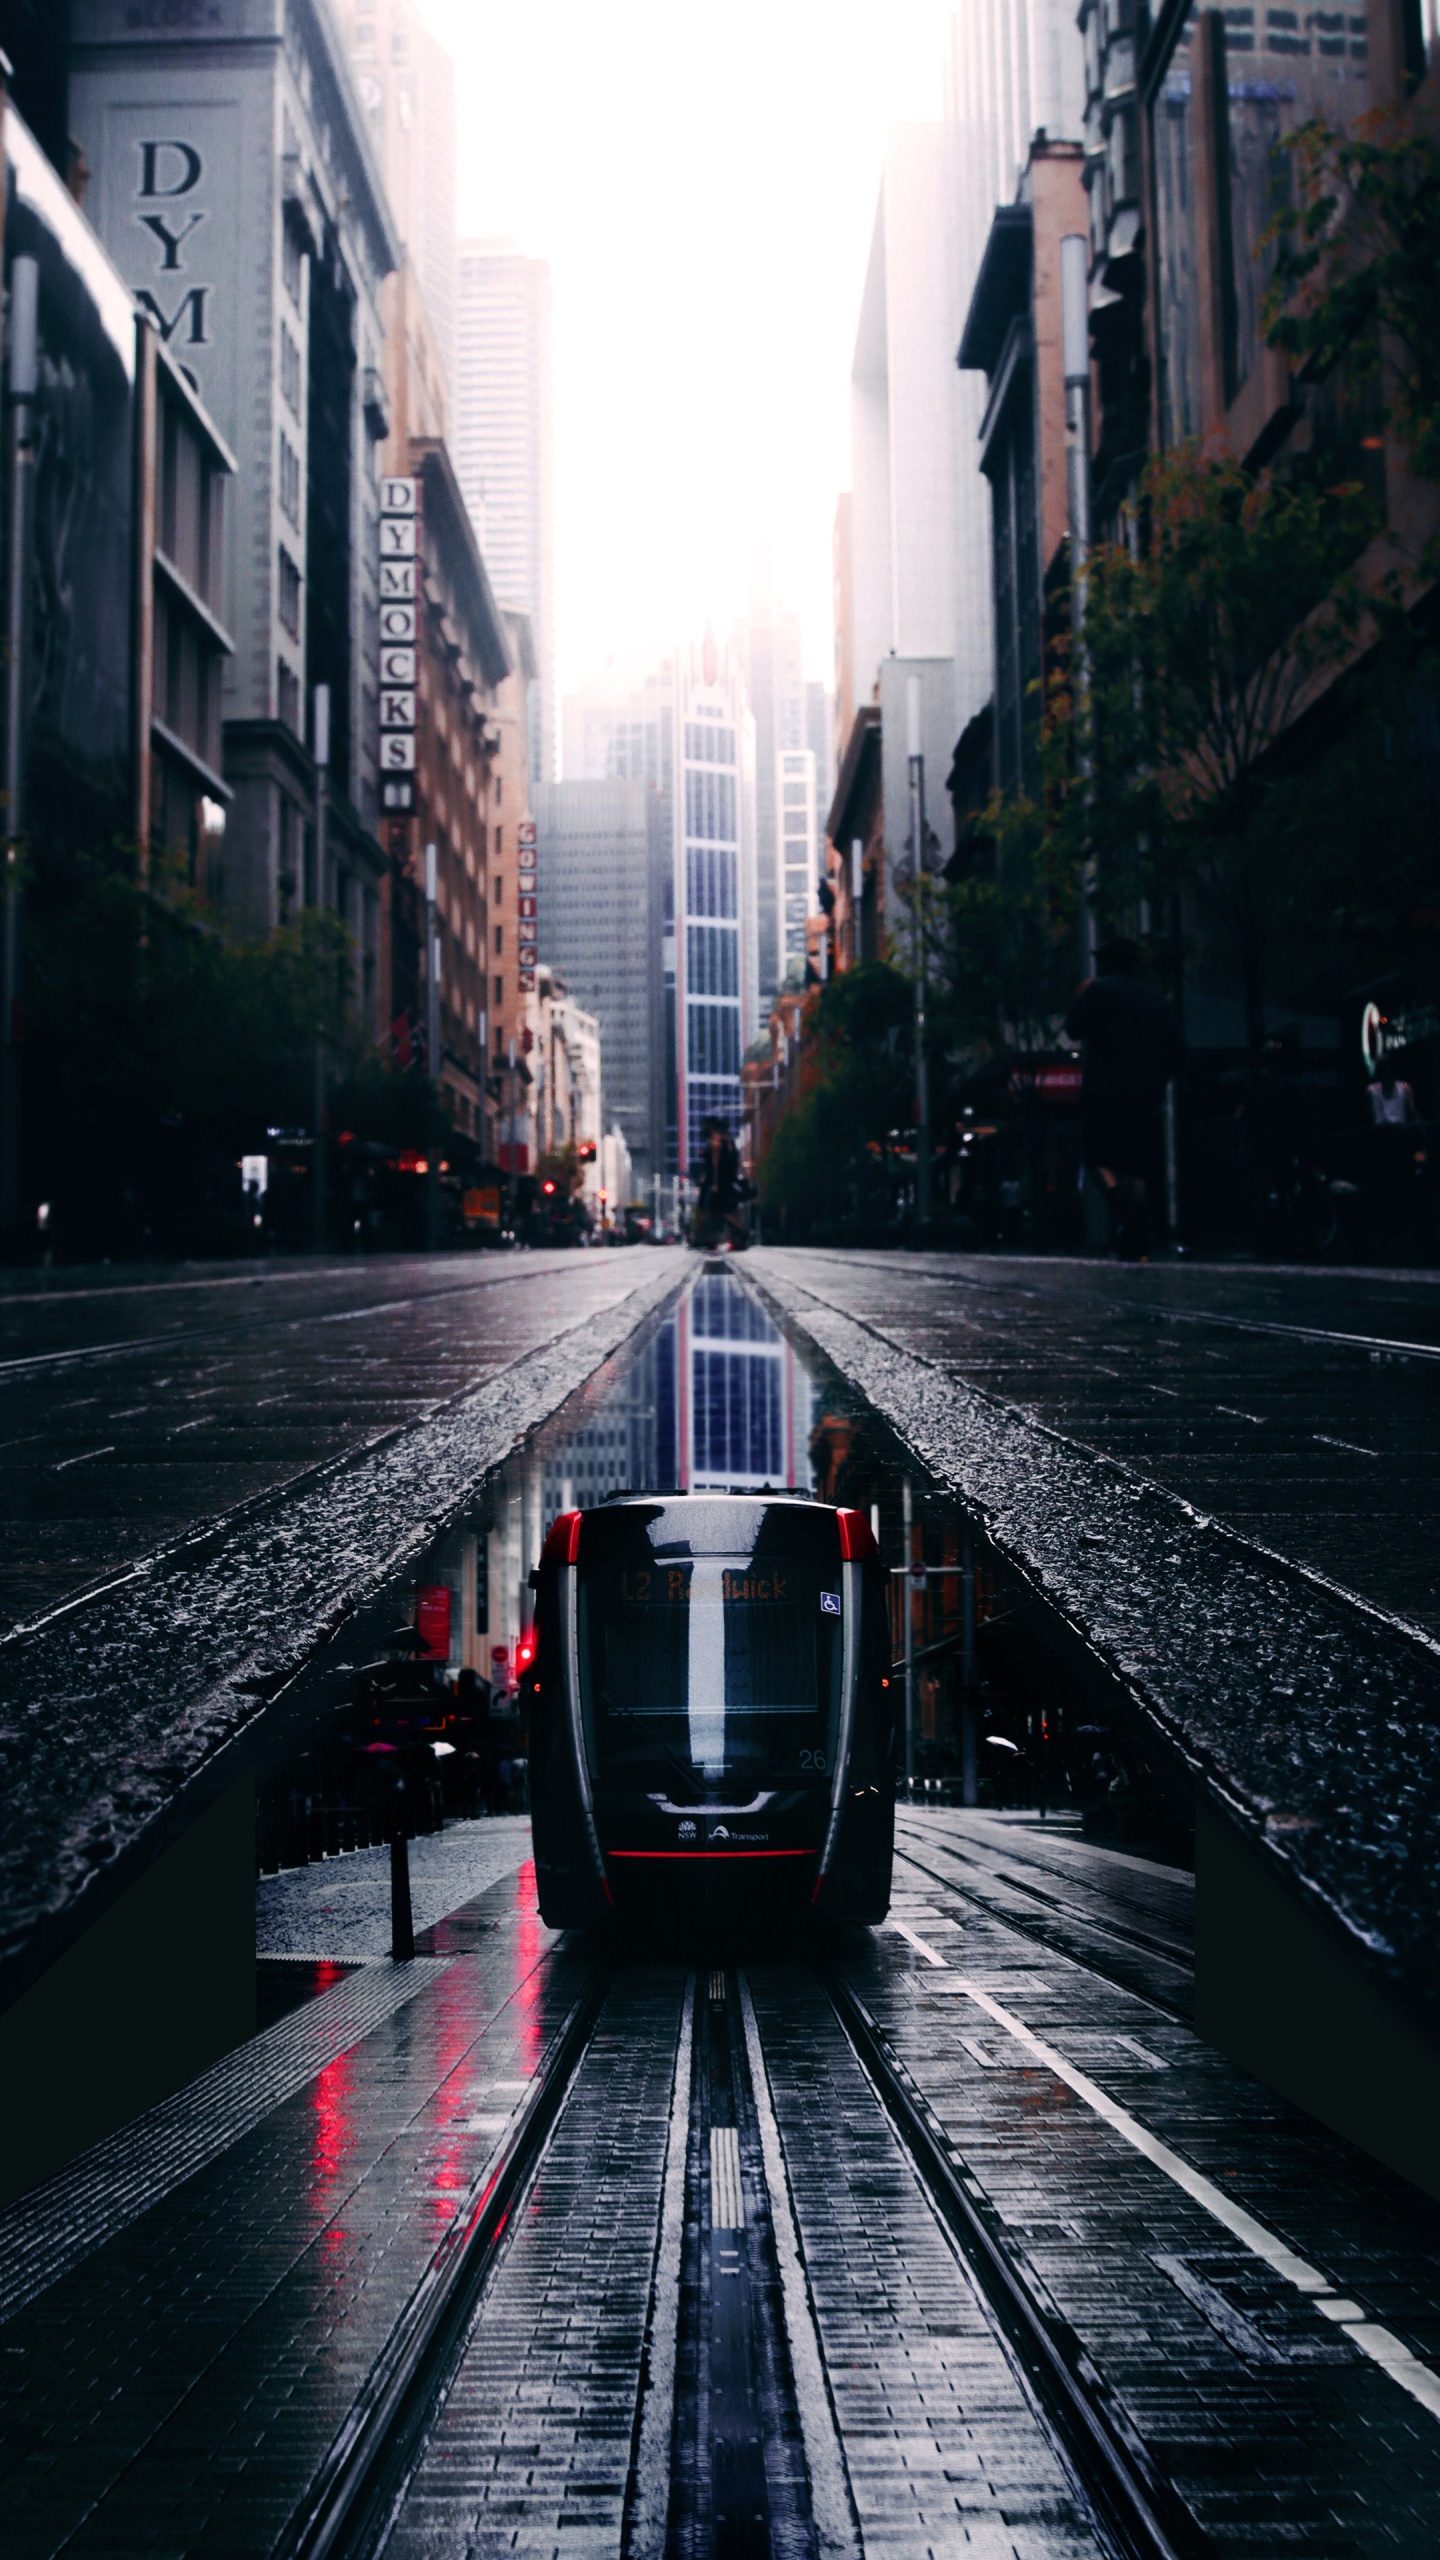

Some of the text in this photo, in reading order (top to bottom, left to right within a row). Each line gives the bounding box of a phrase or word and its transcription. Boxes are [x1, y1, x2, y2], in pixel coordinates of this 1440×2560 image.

[132, 139, 208, 394] DYM
[384, 482, 412, 769] DYMOCKS
[518, 823, 537, 991] GOWINGS
[620, 1570, 651, 1601] L2
[799, 1749, 826, 1770] 26
[678, 1831, 697, 1840] NSW
[731, 1832, 769, 1842] Transport
